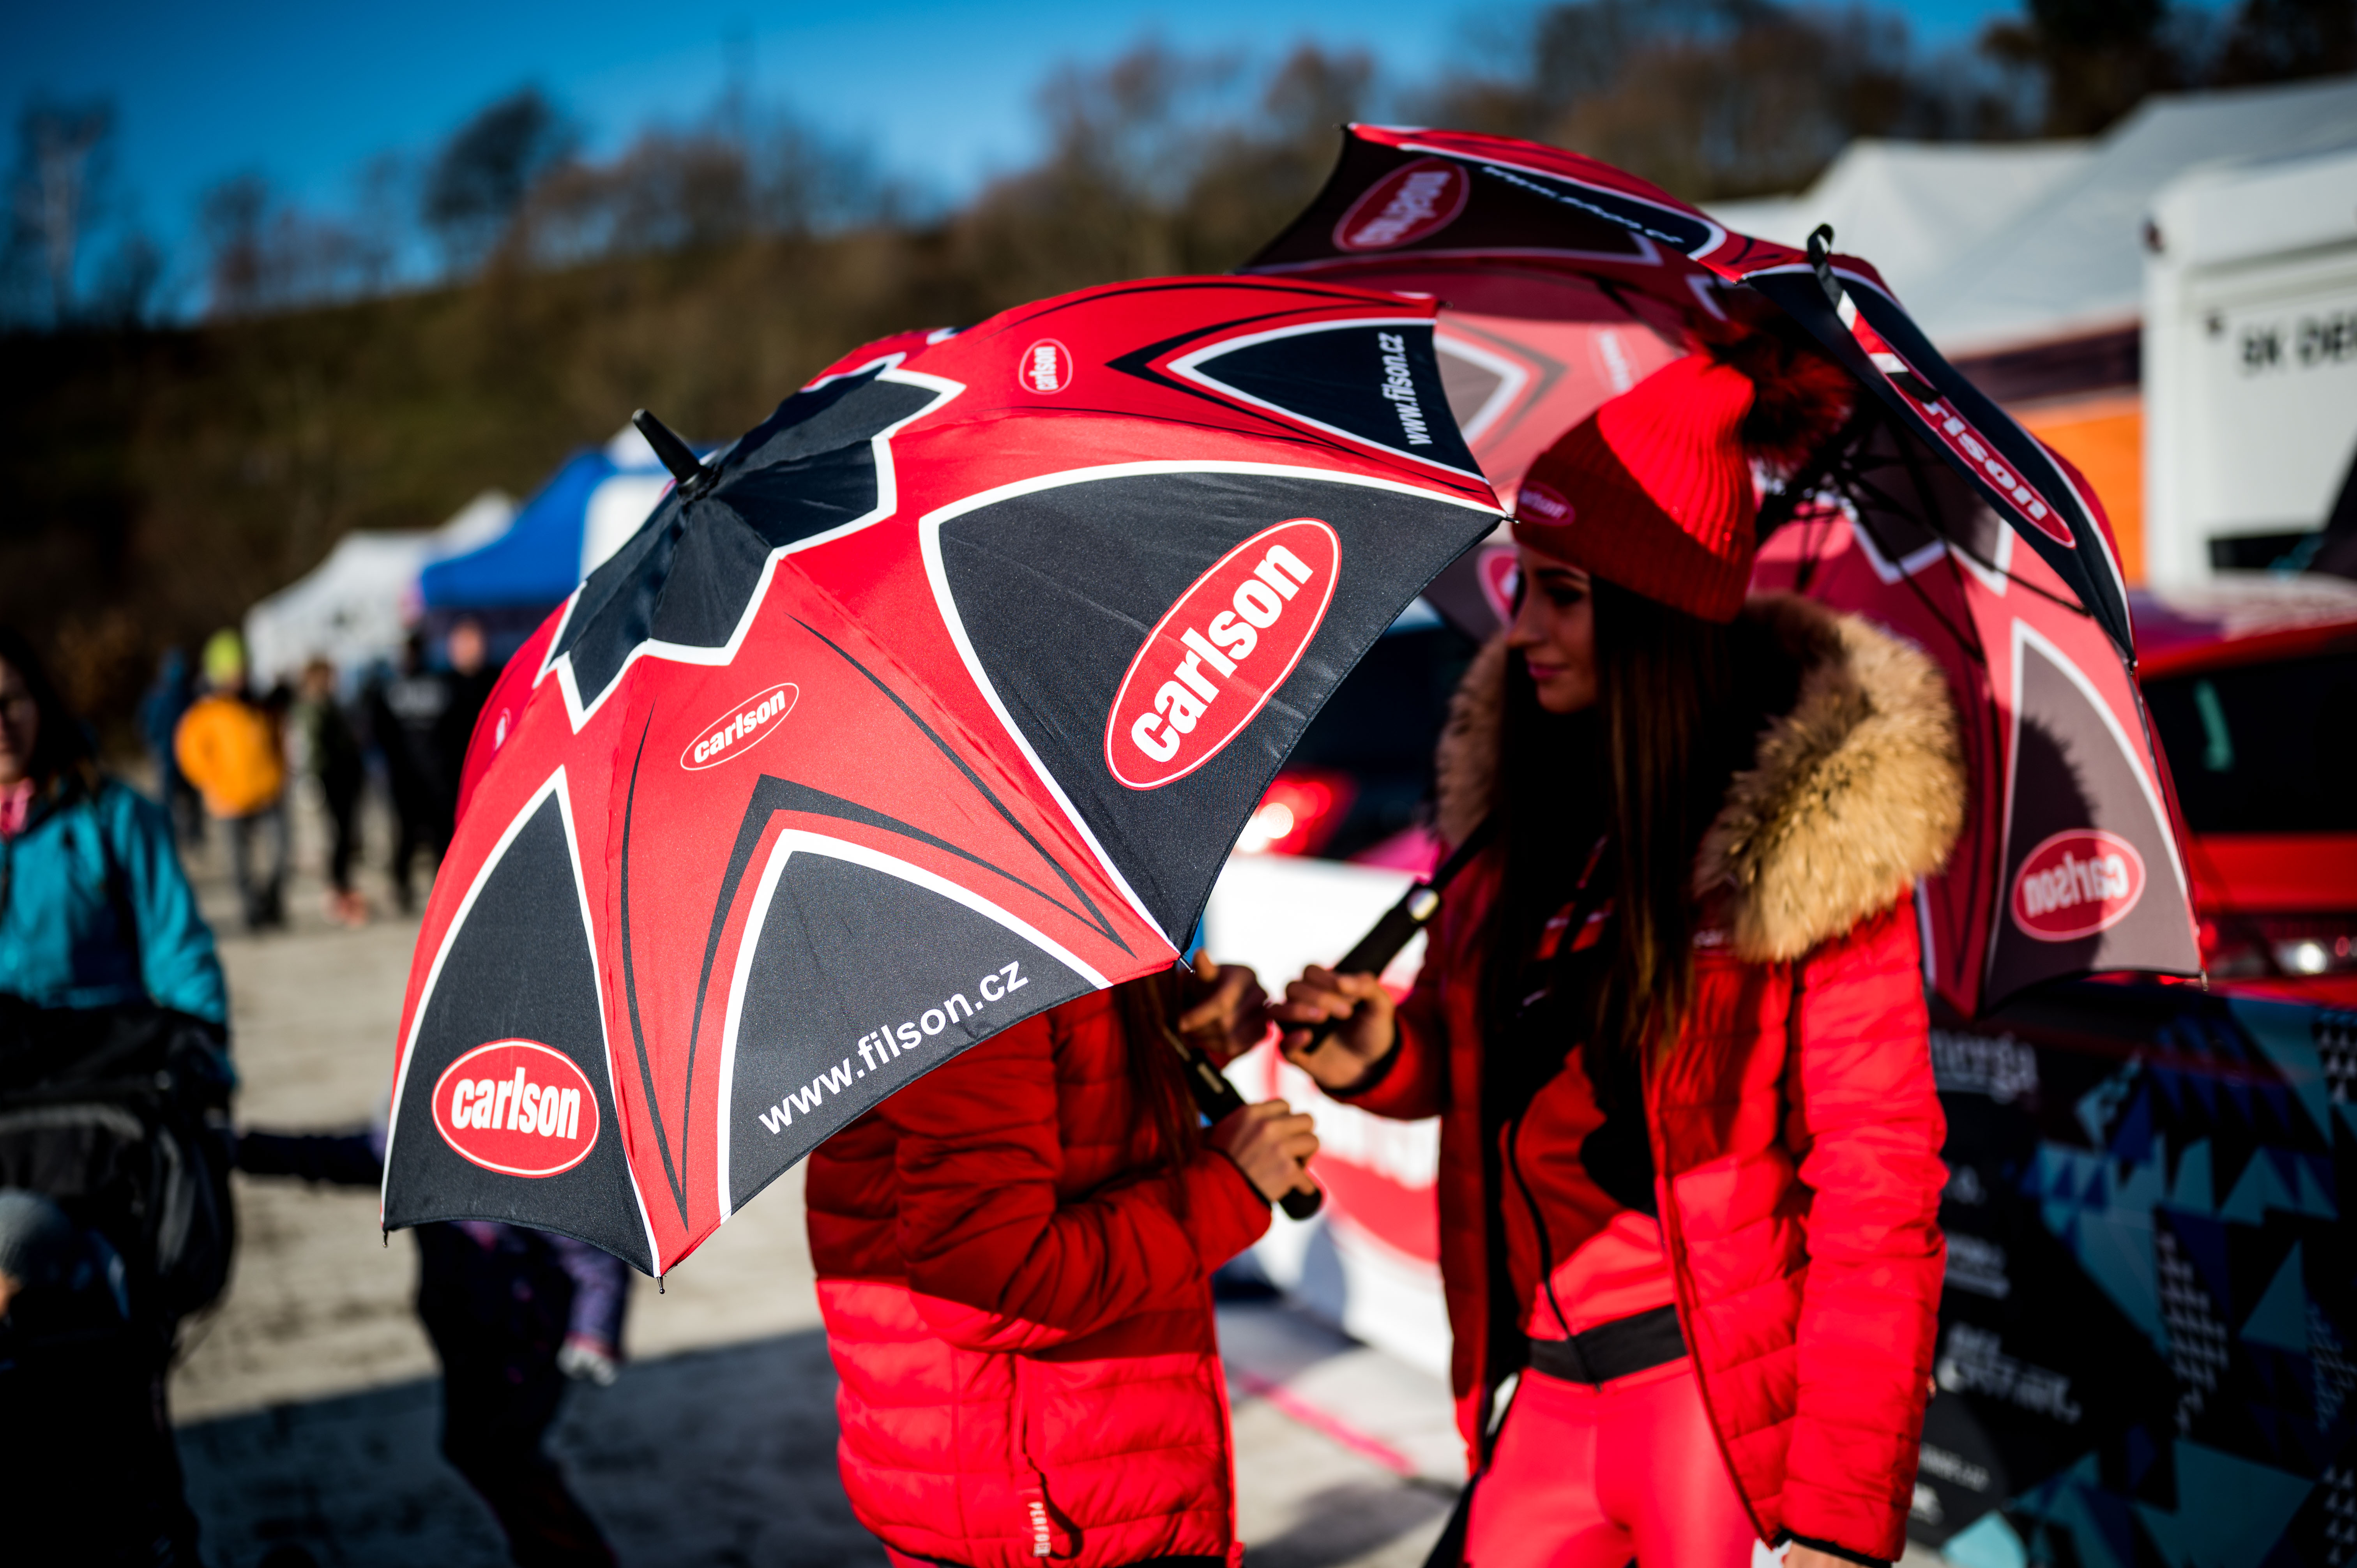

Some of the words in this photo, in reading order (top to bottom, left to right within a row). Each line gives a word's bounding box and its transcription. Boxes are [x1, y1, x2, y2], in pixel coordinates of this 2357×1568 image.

[1028, 346, 1059, 390] carlson
[1378, 332, 1433, 445] www.filson.cz
[1131, 545, 1313, 763] carlson
[694, 690, 785, 763] carlson
[758, 961, 1028, 1134] www.filson.cz
[451, 1067, 581, 1139] carlson
